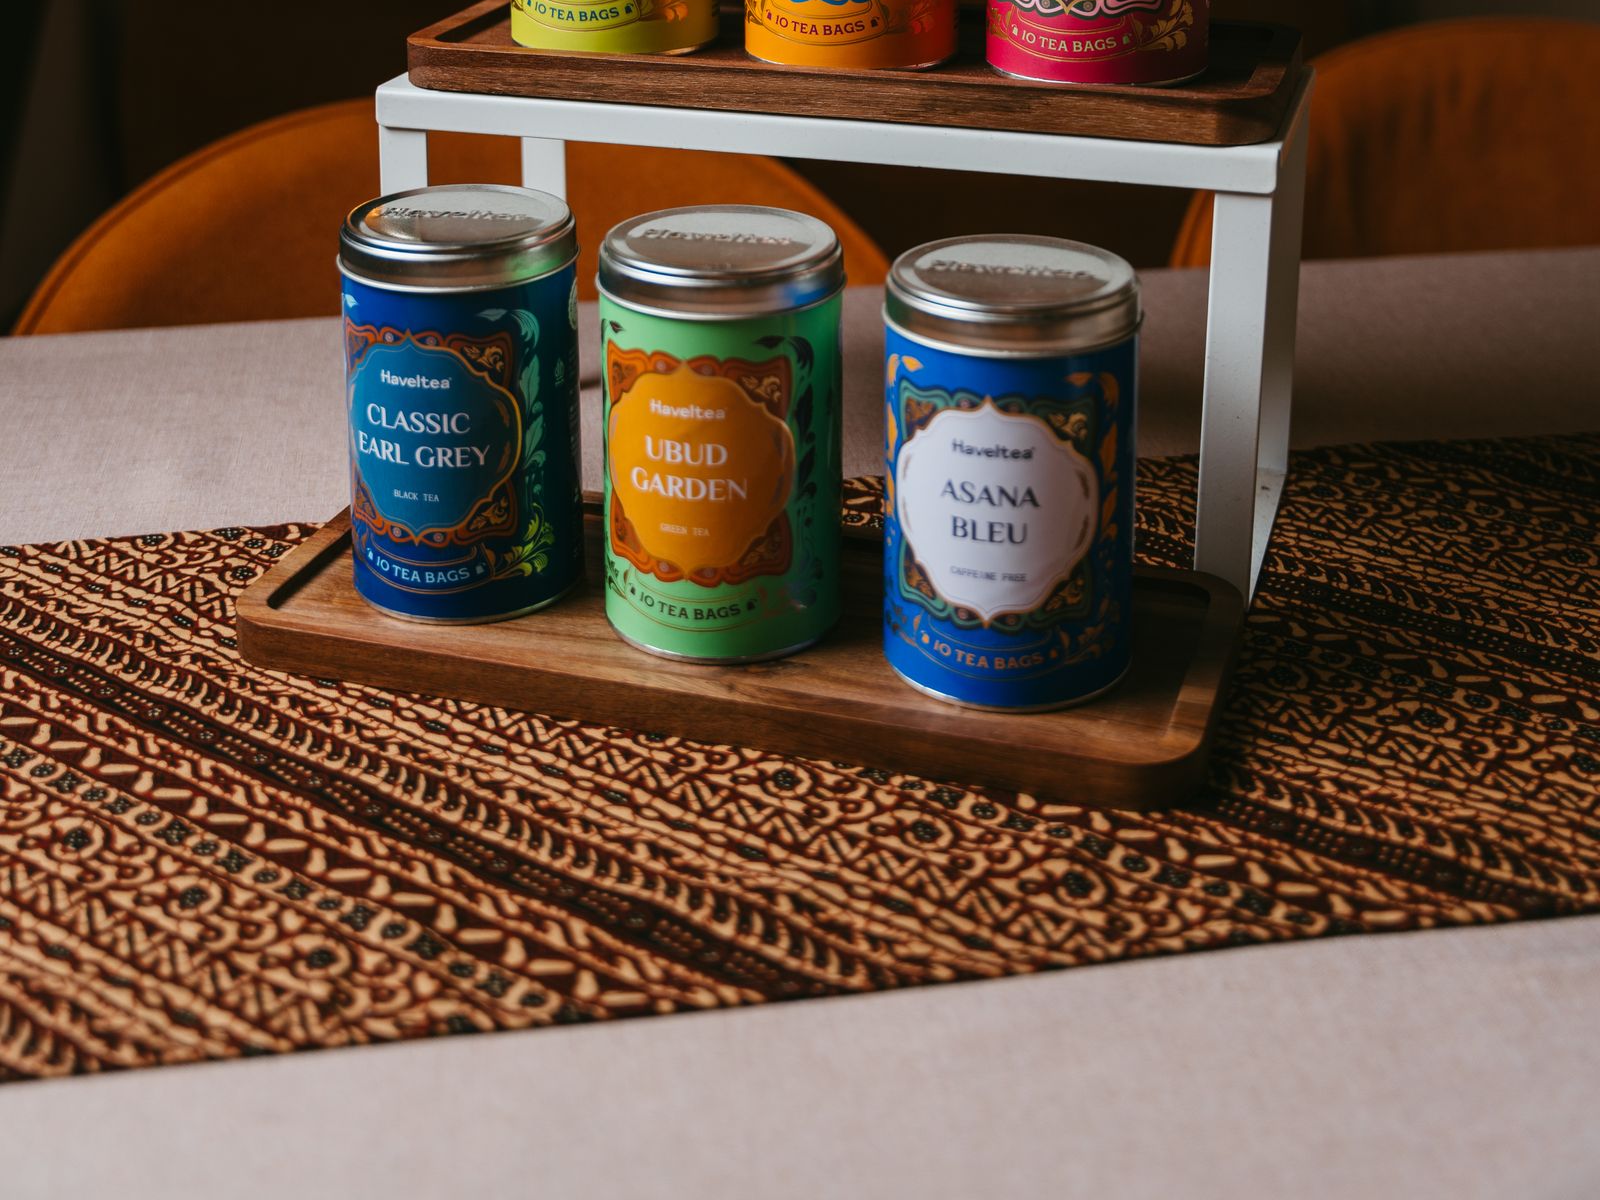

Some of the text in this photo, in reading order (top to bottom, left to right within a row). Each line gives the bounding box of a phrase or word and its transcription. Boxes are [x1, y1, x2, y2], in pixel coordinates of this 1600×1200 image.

[549, 6, 574, 21] TEA
[579, 7, 620, 21] BAGS
[792, 20, 819, 35] TEA
[823, 21, 865, 35] BAGS
[1040, 34, 1068, 51] TEA
[1072, 37, 1117, 52] BAGS
[380, 370, 450, 389] Haveltea
[367, 403, 470, 434] CLASSIC
[650, 399, 726, 419] Haveltea
[358, 431, 490, 468] EARL GREY
[644, 436, 727, 465] UBUD
[952, 439, 1033, 460] Haveltea
[631, 467, 747, 500] GARDEN
[941, 479, 1040, 508] ASANA
[394, 489, 439, 502] BLACK TEA
[660, 523, 710, 536] GREEN TEA
[951, 516, 1028, 544] BLEU
[392, 565, 421, 582] TEA
[425, 567, 469, 583] BAGS
[950, 566, 1027, 582] CAFFEINE FREE
[657, 600, 688, 620] TEA
[694, 603, 741, 620] BAGS
[955, 649, 988, 668] TEA
[995, 652, 1043, 669] BAGS
